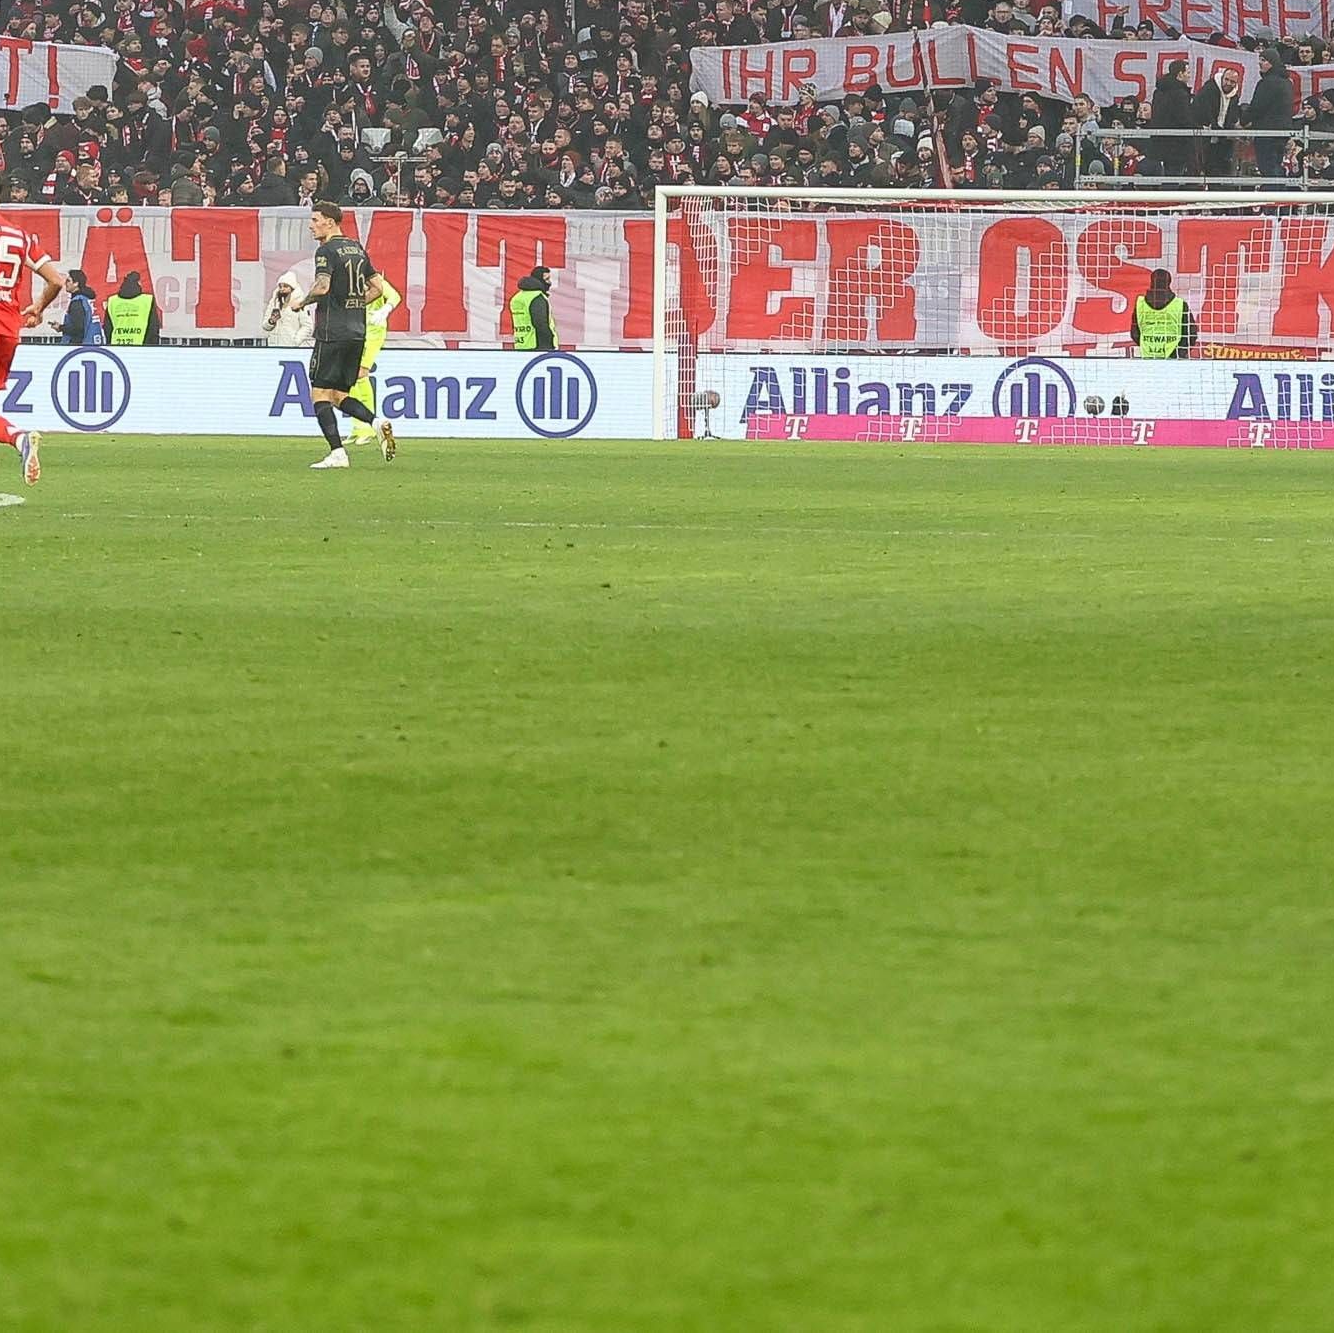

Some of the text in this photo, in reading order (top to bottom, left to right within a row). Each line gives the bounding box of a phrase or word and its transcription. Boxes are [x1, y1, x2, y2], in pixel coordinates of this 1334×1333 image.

[721, 47, 818, 100] IHR
[843, 32, 1083, 97] BULLEN
[345, 258, 366, 297] 16
[623, 218, 922, 341] DER
[739, 365, 973, 423] Allianz
